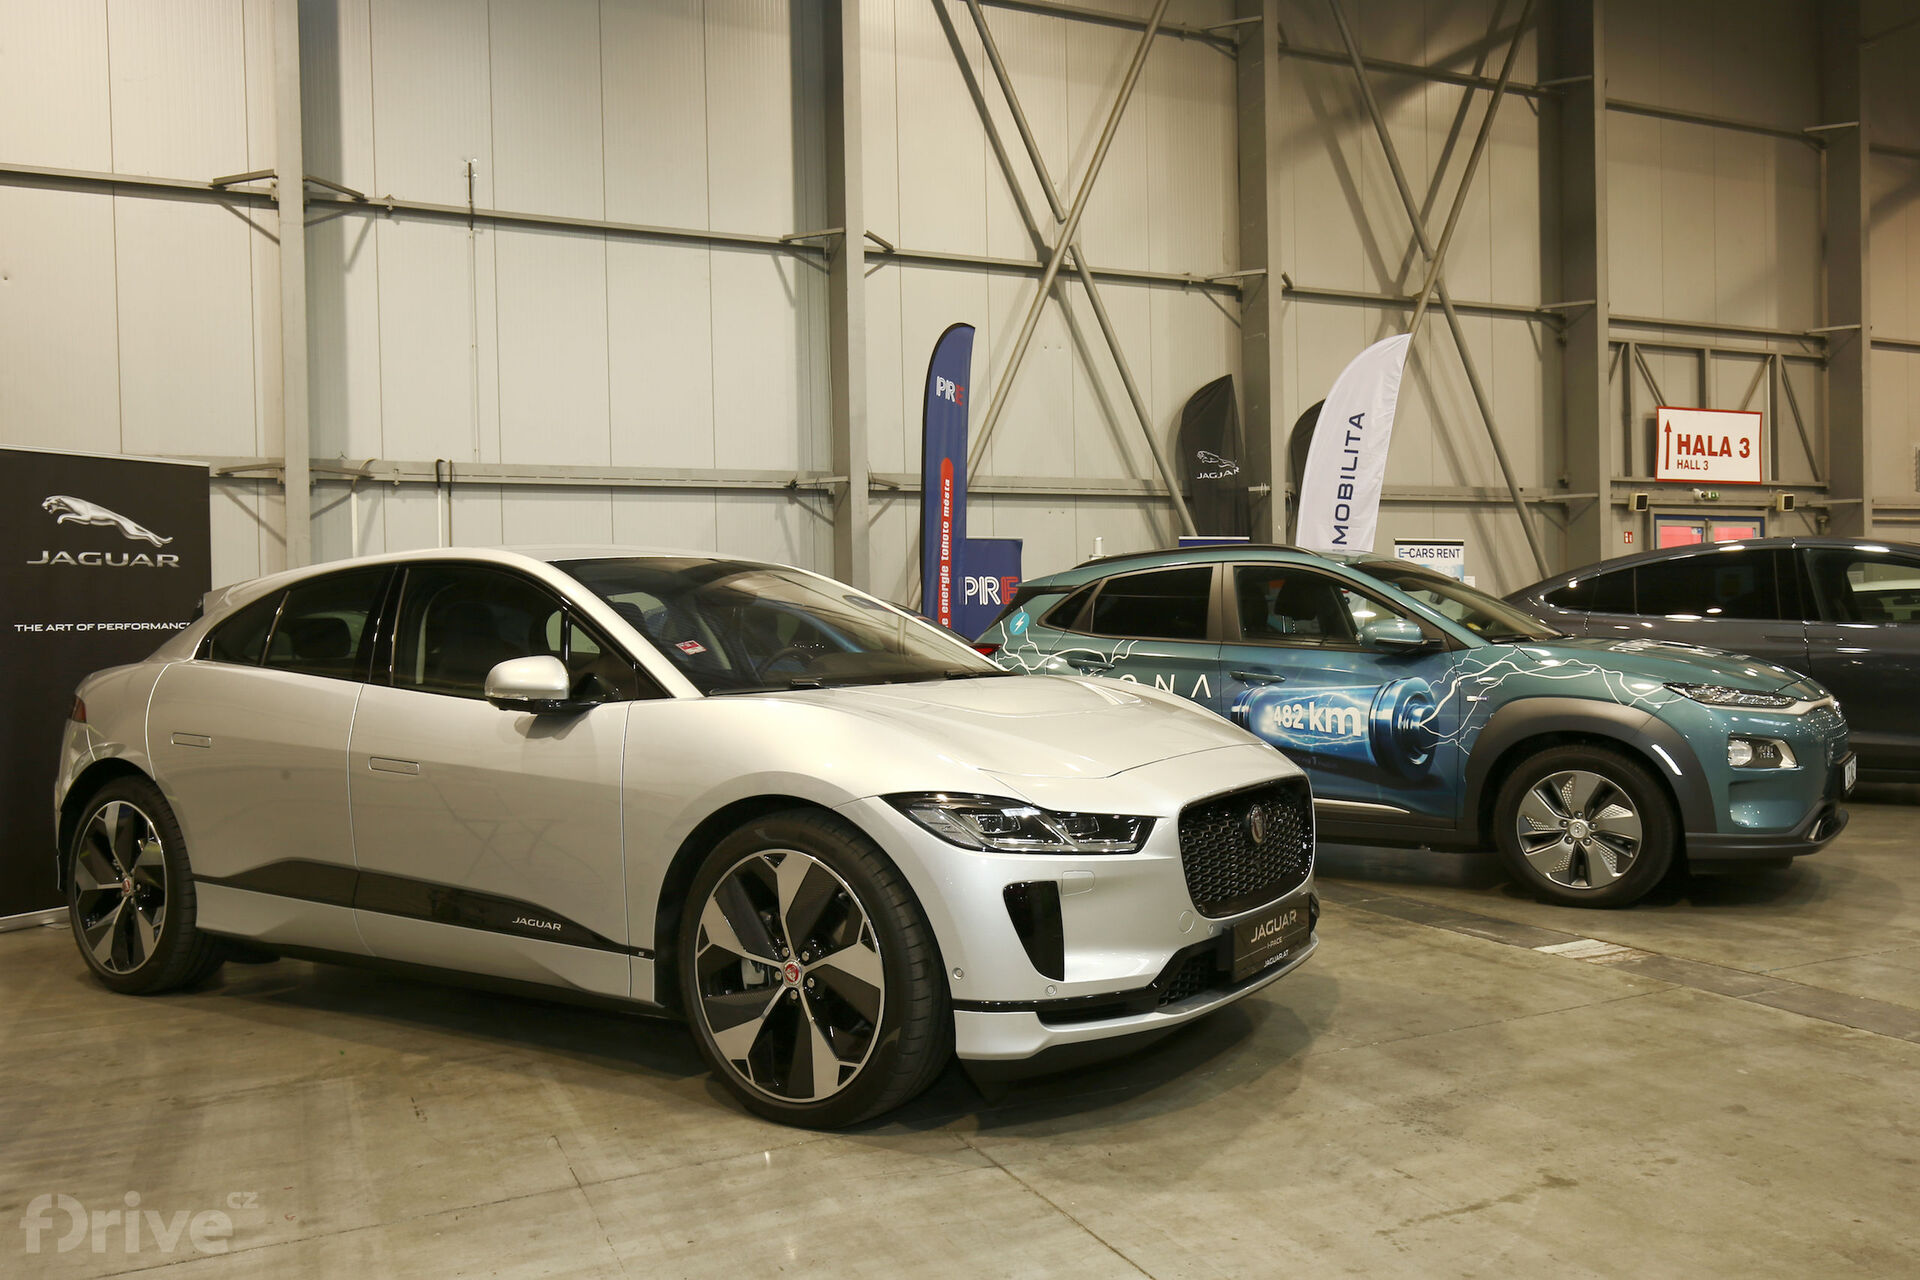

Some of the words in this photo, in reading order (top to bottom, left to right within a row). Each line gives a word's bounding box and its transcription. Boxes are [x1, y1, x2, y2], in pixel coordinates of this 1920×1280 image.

[1677, 433, 1732, 457] HALA
[1739, 437, 1750, 458] 3
[1677, 459, 1701, 470] HALL
[1703, 460, 1709, 471] 3
[1331, 411, 1366, 546] MOBILITA
[26, 550, 181, 568] JAGUAR
[1436, 548, 1461, 559] RENT
[14, 624, 44, 632] THE
[46, 623, 74, 632] ART
[76, 623, 95, 631] OF
[97, 622, 191, 631] PERFORMANC
[1273, 703, 1304, 730] 482
[1308, 701, 1362, 737] km
[512, 917, 562, 931] JAGUAR
[1250, 909, 1297, 943] JAGUAR
